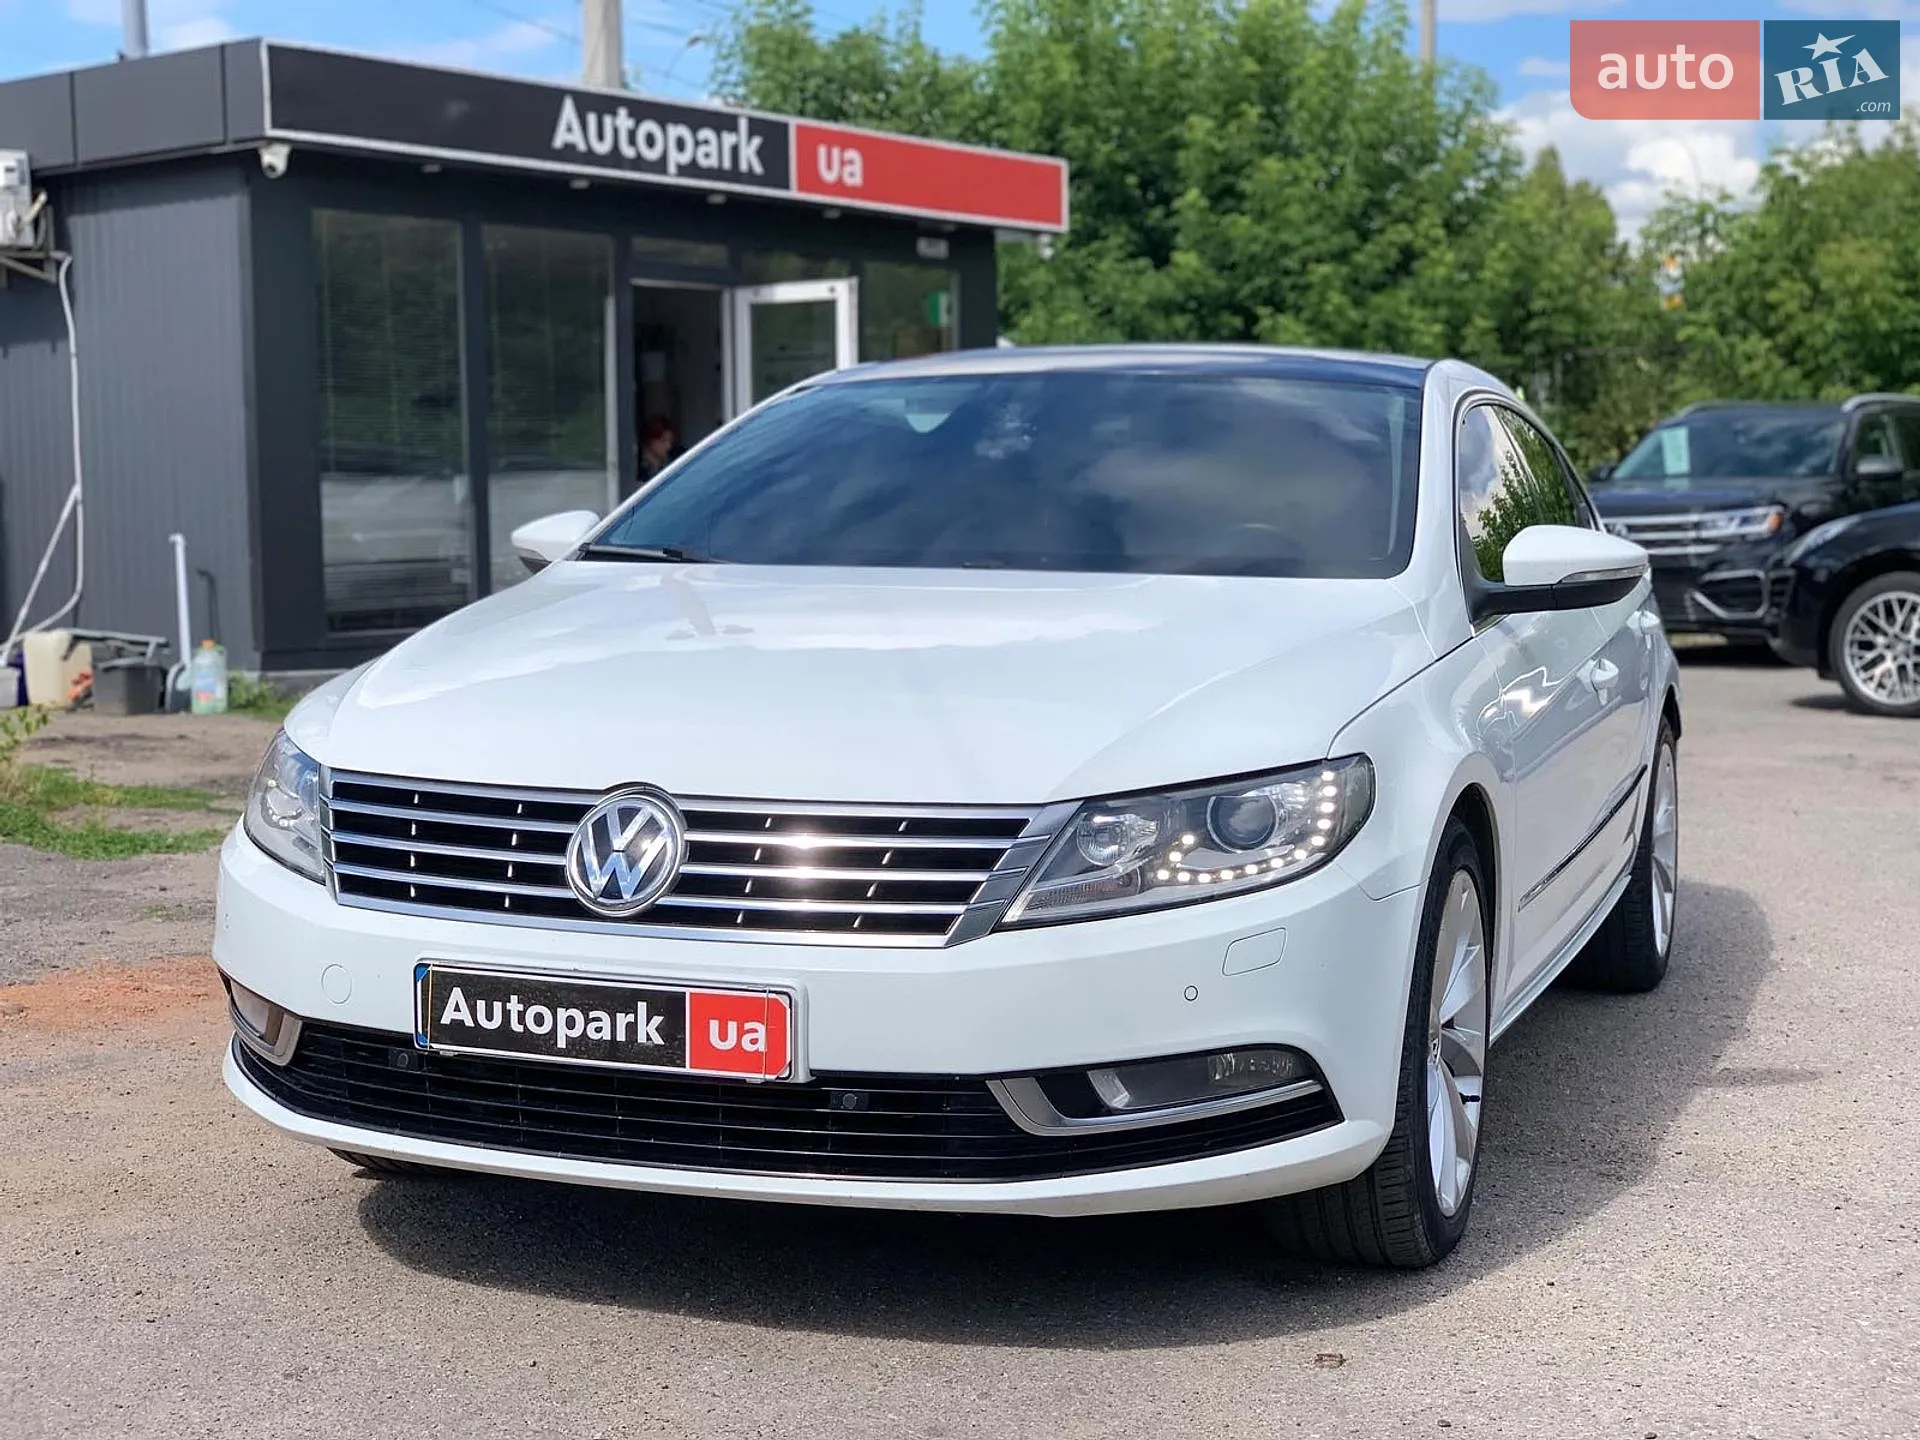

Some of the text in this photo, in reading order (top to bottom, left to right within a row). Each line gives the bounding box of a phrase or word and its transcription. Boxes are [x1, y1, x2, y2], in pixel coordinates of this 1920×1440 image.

[551, 95, 865, 187] Autopark ua
[440, 987, 767, 1052] Autopark ua
